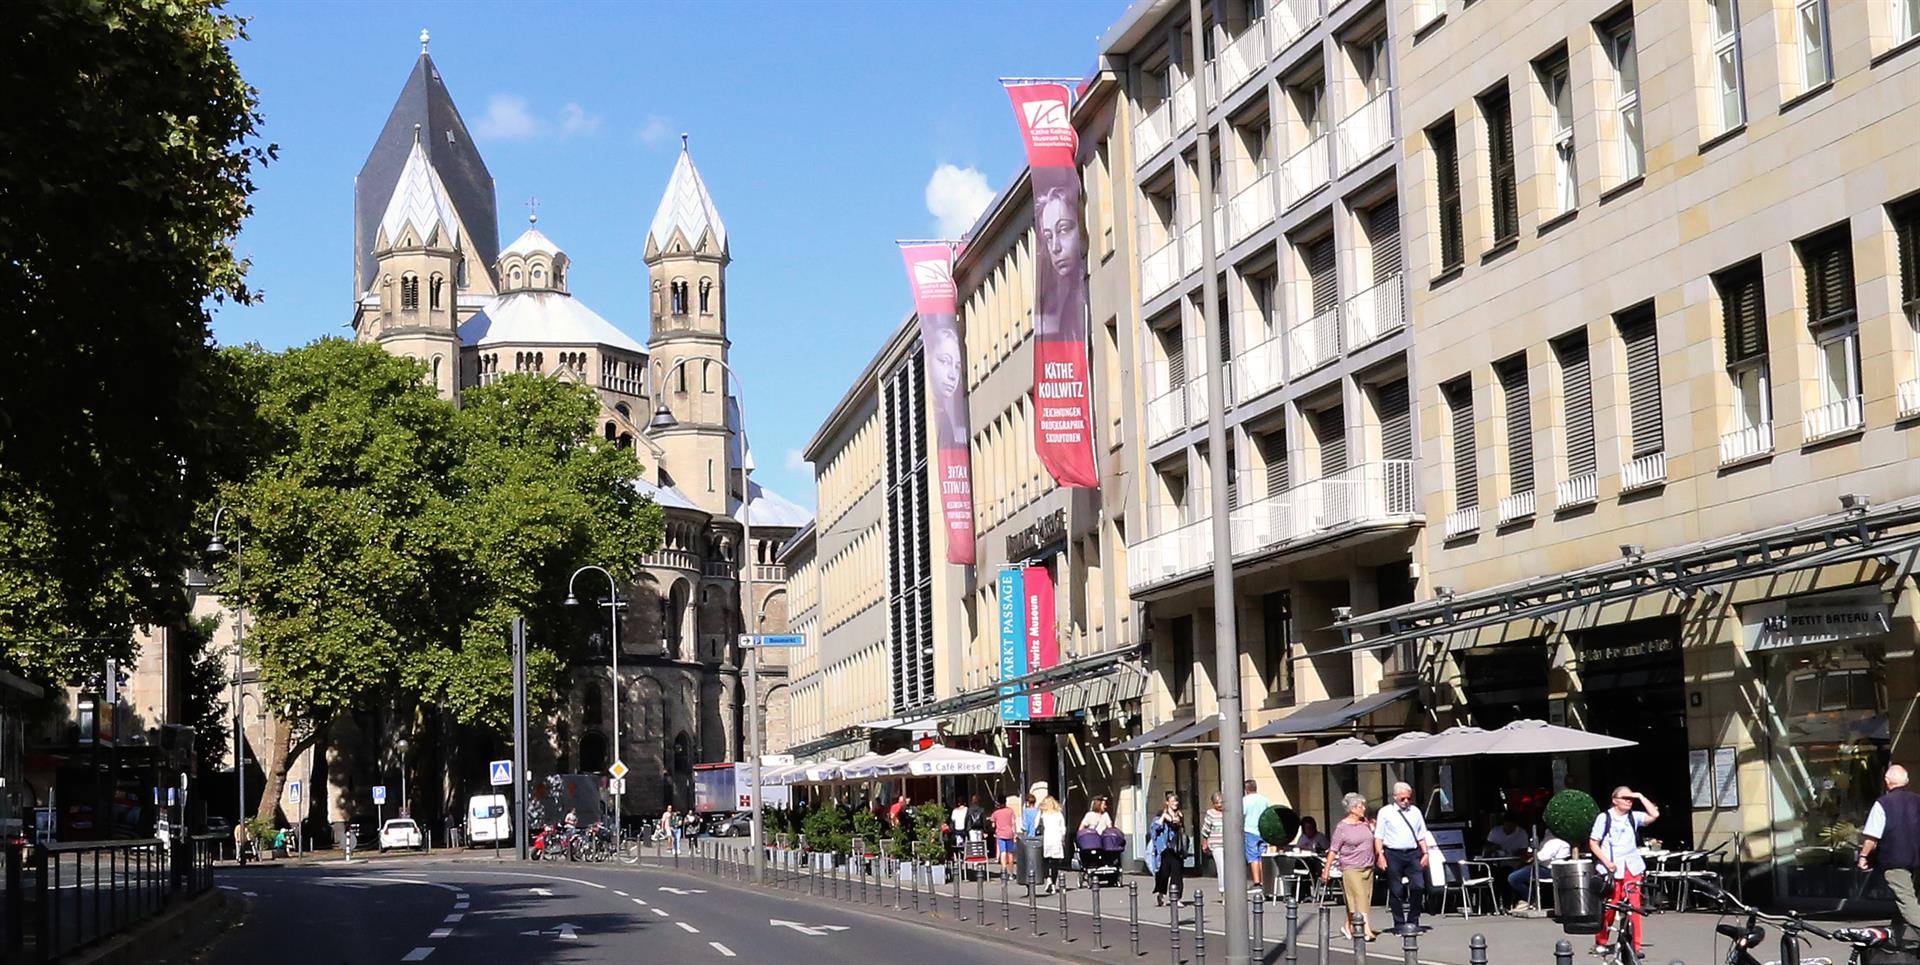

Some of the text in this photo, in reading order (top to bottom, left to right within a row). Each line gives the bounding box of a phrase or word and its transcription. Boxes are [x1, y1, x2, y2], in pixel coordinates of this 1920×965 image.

[1044, 362, 1074, 379] KÄTHE
[1038, 382, 1084, 398] KOLLWITZ
[1002, 575, 1013, 634] PASSAGE
[1029, 595, 1041, 637] Museum
[1791, 614, 1823, 626] PETIT
[1826, 612, 1869, 624] BATEAU
[935, 762, 982, 772] Café Riese
